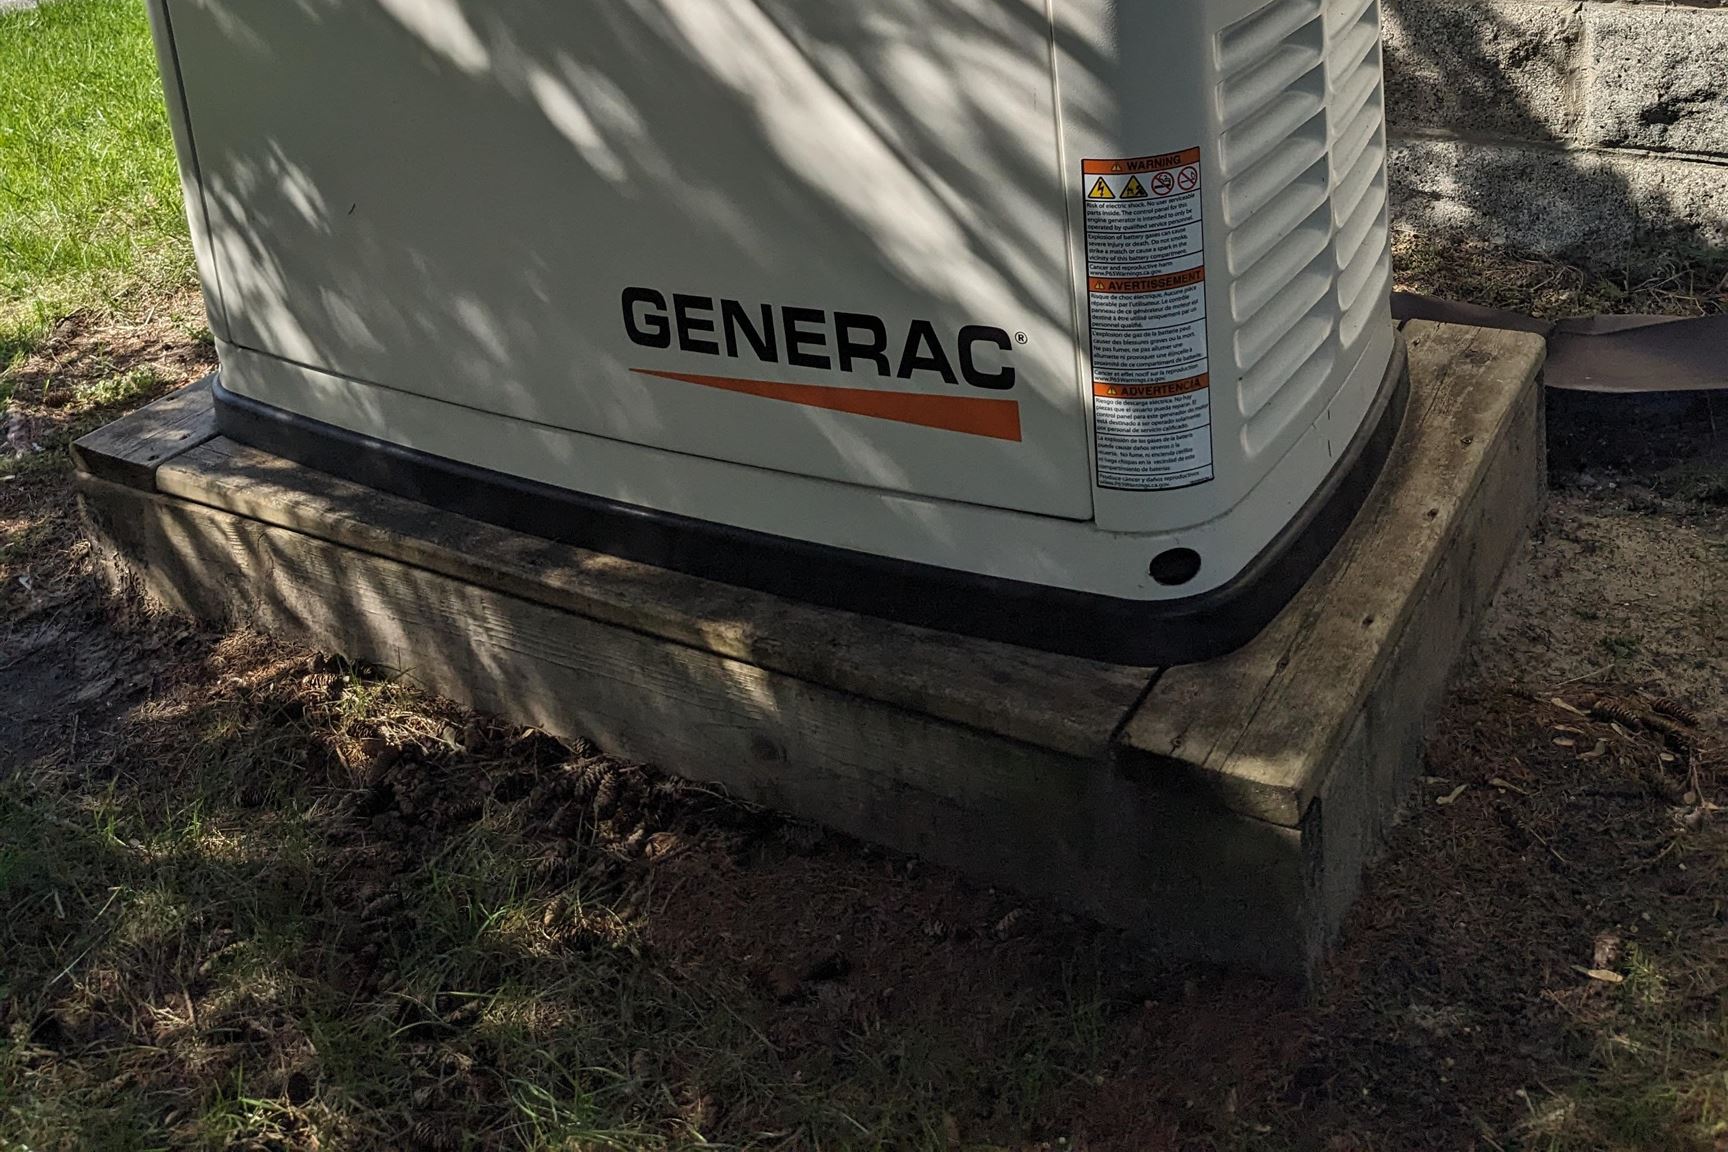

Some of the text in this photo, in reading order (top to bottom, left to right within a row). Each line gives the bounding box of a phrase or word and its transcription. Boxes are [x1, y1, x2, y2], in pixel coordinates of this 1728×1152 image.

[1126, 155, 1181, 171] WARNING
[1168, 192, 1195, 204] serviceable
[1087, 209, 1101, 217] parts
[1154, 205, 1169, 215] panel
[1178, 201, 1187, 209] this
[1088, 216, 1107, 224] engine
[1108, 216, 1136, 224] generator
[1142, 213, 1167, 222] intended
[1174, 209, 1185, 218] only
[1088, 223, 1113, 231] operated
[1122, 223, 1147, 231] qualified
[1148, 220, 1167, 228] service
[1088, 233, 1115, 242] Explosion
[1123, 233, 1144, 242] battery
[1144, 232, 1160, 240] gases
[1171, 227, 1186, 235] cause
[1107, 241, 1124, 249] injury
[1157, 244, 1171, 253] spark
[1178, 240, 1187, 248] the
[1089, 254, 1109, 263] vicinity
[1129, 254, 1149, 263] battery
[1122, 262, 1157, 272] reproductive
[1108, 270, 1201, 291] AVERTISSEMENT
[1091, 293, 1110, 301] Risque
[1164, 288, 1183, 297] Aucune
[1092, 307, 1116, 315] panneau
[1181, 309, 1189, 317] par
[1092, 320, 1120, 329] personnel
[1158, 327, 1179, 336] batterie
[1180, 324, 1191, 334] peut
[1150, 337, 1168, 346] graves
[1121, 377, 1200, 397] ADVERTENCIA
[1096, 411, 1116, 419] control
[1116, 413, 1133, 421] panel
